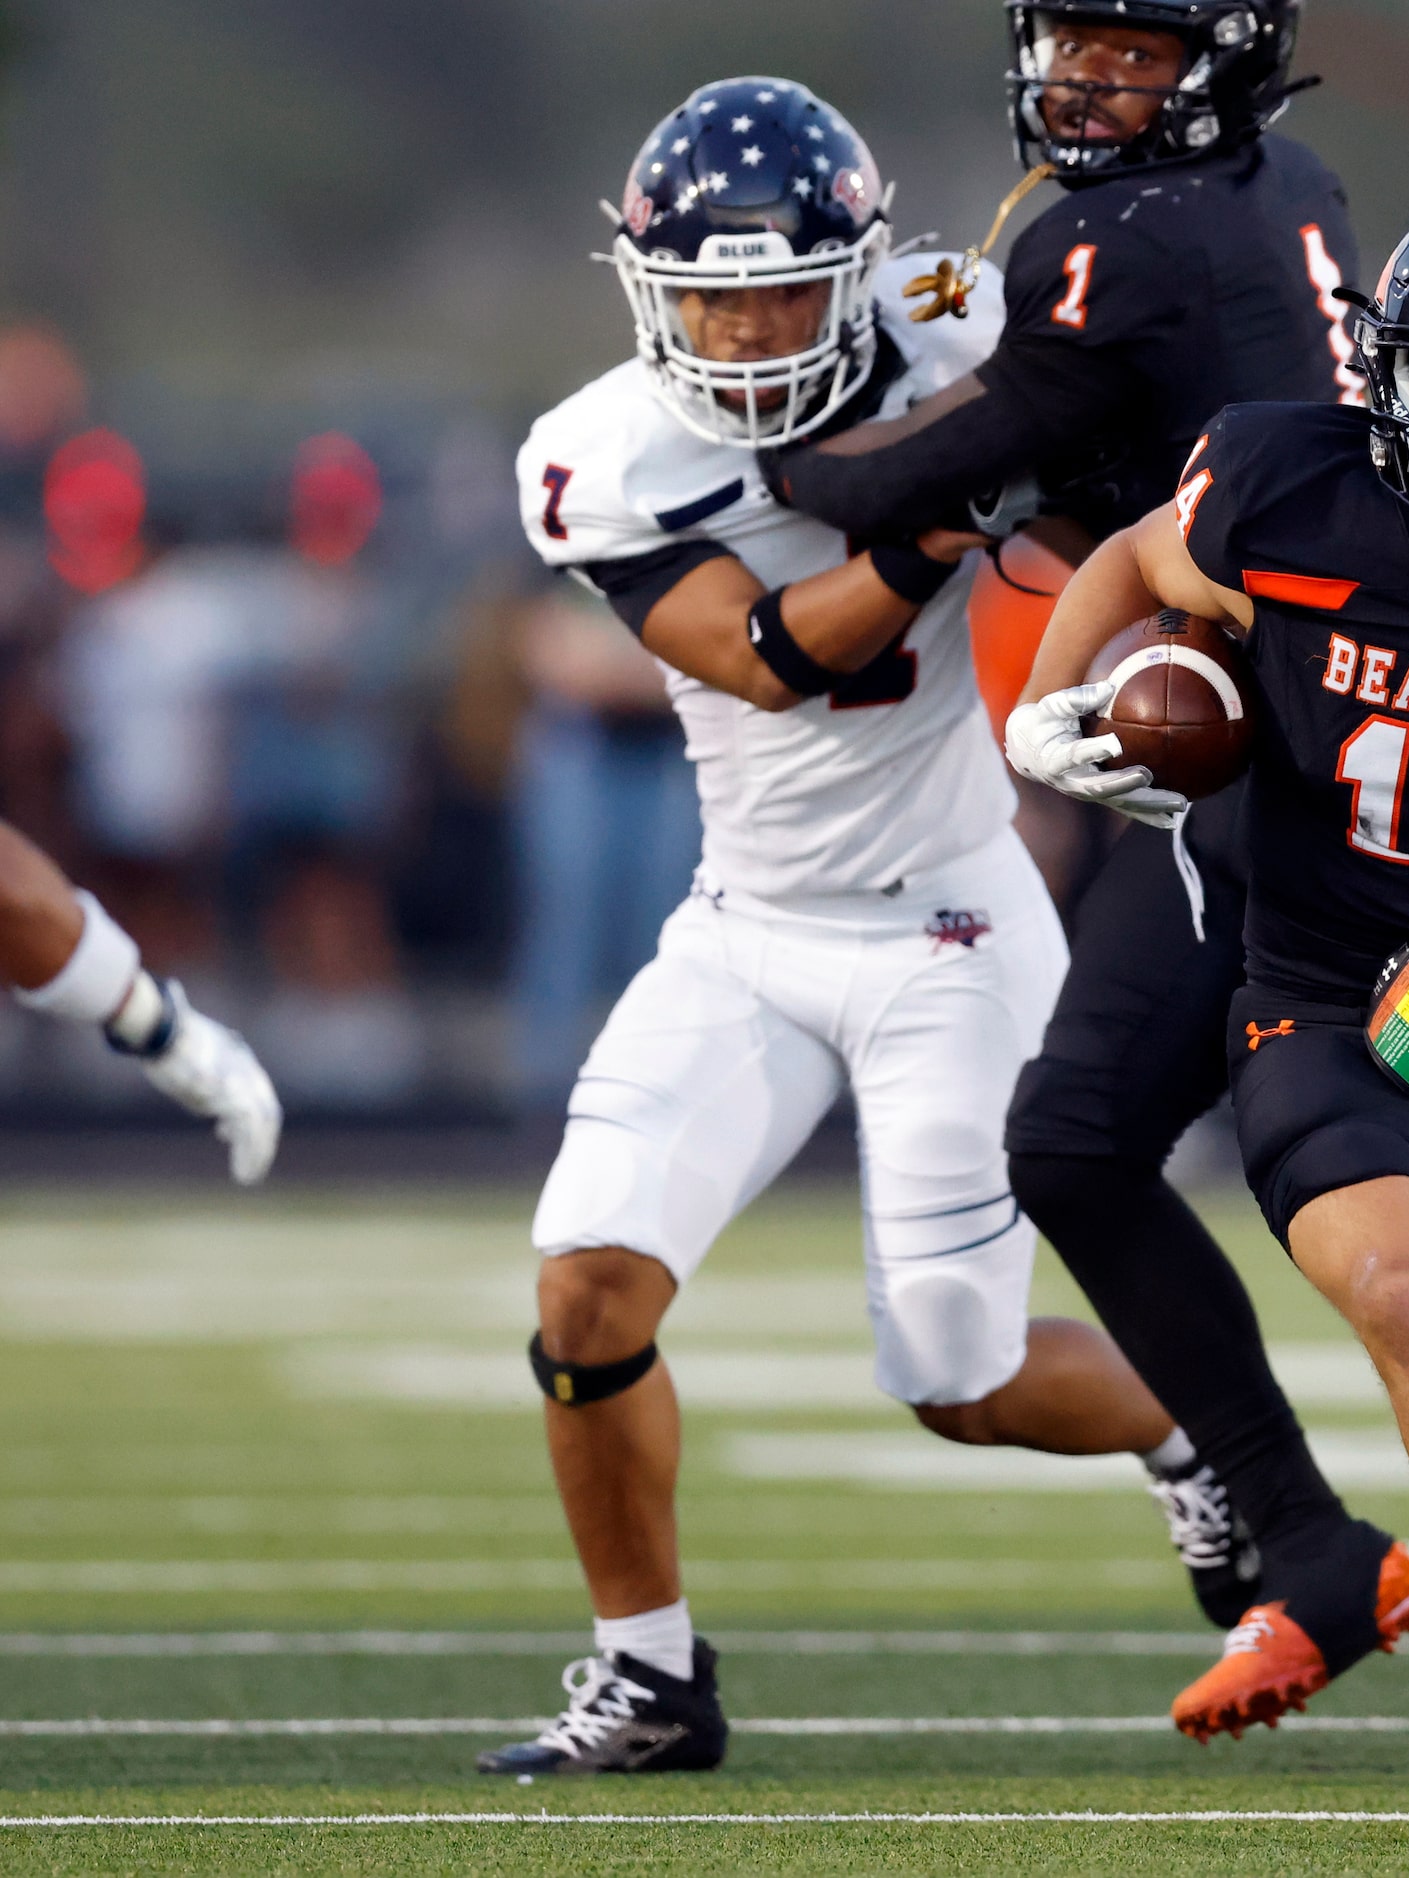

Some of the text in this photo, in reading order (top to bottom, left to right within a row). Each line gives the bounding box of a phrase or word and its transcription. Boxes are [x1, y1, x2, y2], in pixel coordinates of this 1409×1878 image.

[717, 243, 767, 258] BLUE
[1052, 243, 1099, 330] 1
[541, 462, 575, 541] 7
